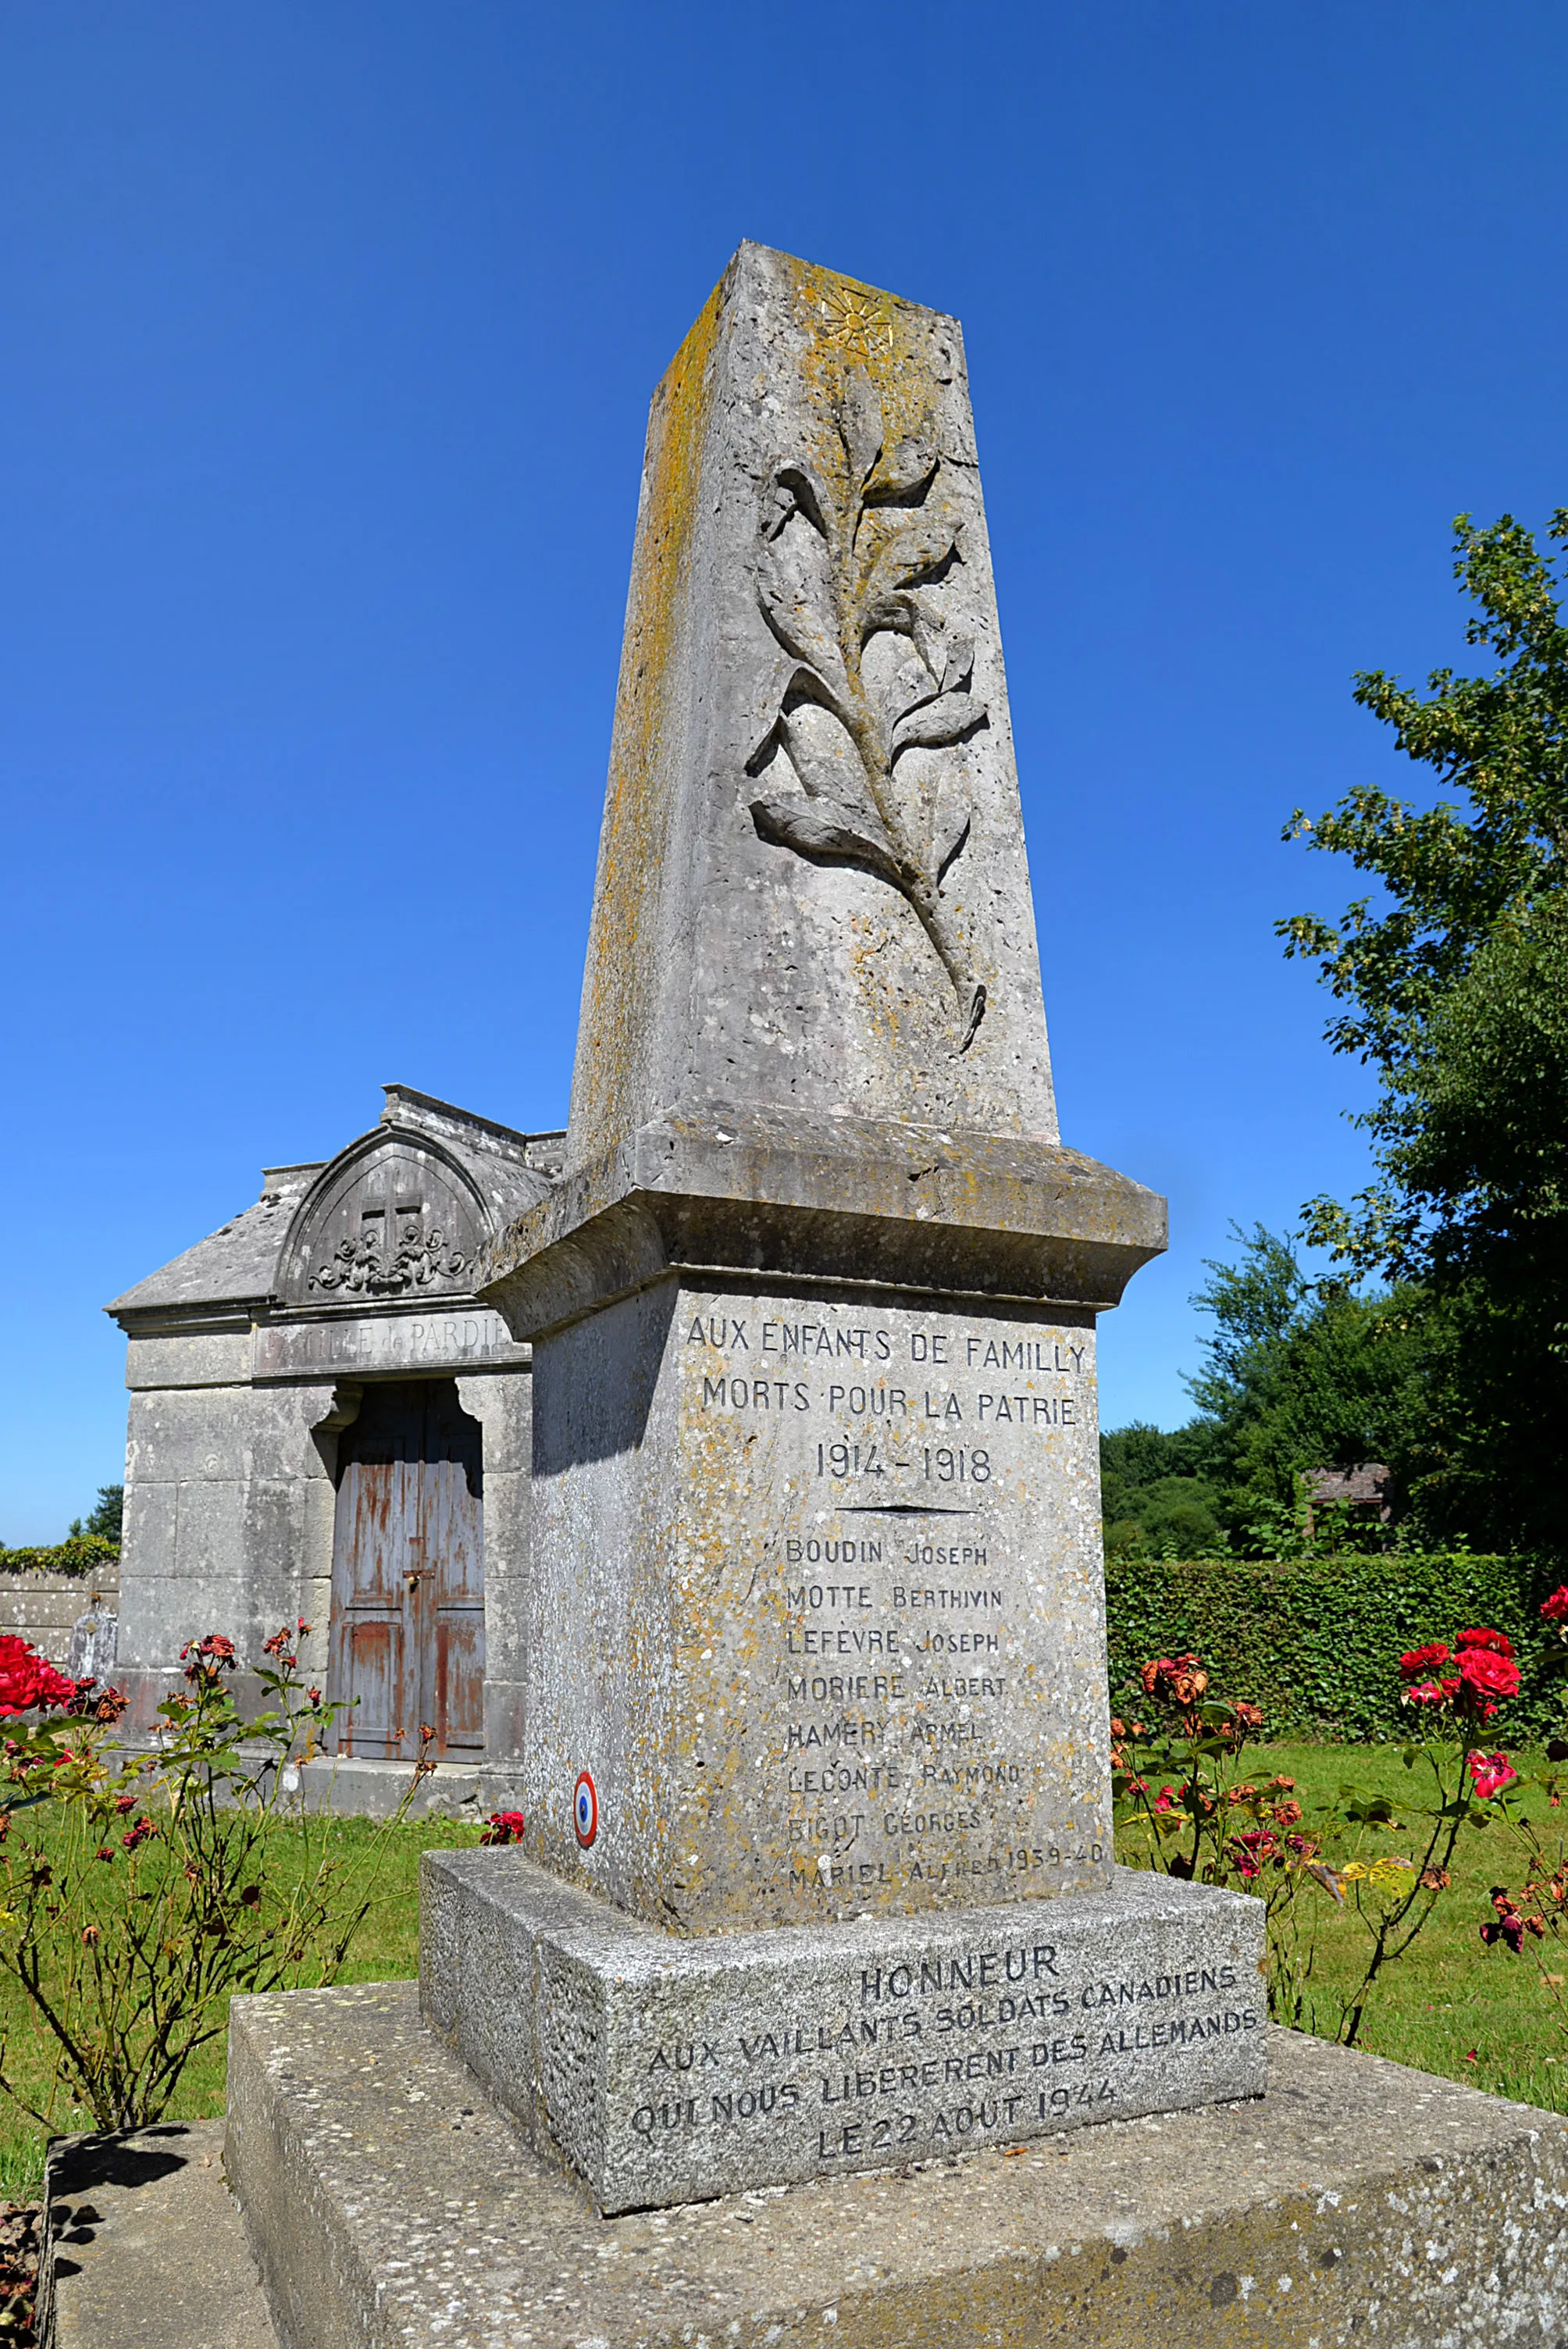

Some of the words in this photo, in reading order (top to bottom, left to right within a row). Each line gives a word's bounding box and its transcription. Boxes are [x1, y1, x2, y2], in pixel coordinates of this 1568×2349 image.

[412, 1317, 509, 1349] PARDIE
[687, 1317, 749, 1349] AUX
[762, 1317, 890, 1360] ENFANTS
[911, 1334, 948, 1364] DE
[967, 1338, 1085, 1374] FAMILLY
[704, 1378, 810, 1411] MORTS
[829, 1385, 907, 1416] POUR
[925, 1392, 961, 1420] LA
[978, 1394, 1075, 1425] PATRIE
[786, 1541, 882, 1563] BOUDIN
[907, 1544, 987, 1566] JOSEPH
[786, 1586, 872, 1609] MOTTE
[893, 1587, 1002, 1608] BERTHIVIN
[916, 1631, 998, 1653] JOSEPH
[925, 1678, 1007, 1697] ALBERT
[788, 1721, 888, 1748] HAMERY
[788, 1766, 900, 1793] LECONTE
[922, 1765, 1019, 1787] RAYMOND
[789, 1814, 864, 1841] BIGOT
[885, 1810, 980, 1836] GEORGES
[860, 1944, 1060, 2000] HONNEUR
[650, 2041, 721, 2076] AUX
[738, 2012, 921, 2061] VAILLANTS
[936, 1990, 1069, 2033] SOLDATS
[1081, 1966, 1236, 2009] CANADIENS
[633, 2101, 697, 2144] QUI
[712, 2083, 800, 2122] NOUS
[822, 2047, 1020, 2104] LIBERERENT
[1032, 2034, 1086, 2066] DES
[1099, 2009, 1256, 2056] ALLEMANDS
[819, 2123, 861, 2159] LE
[870, 2115, 916, 2151] 22
[930, 2094, 1024, 2140] AOUT
[1038, 2080, 1117, 2120] 1944
